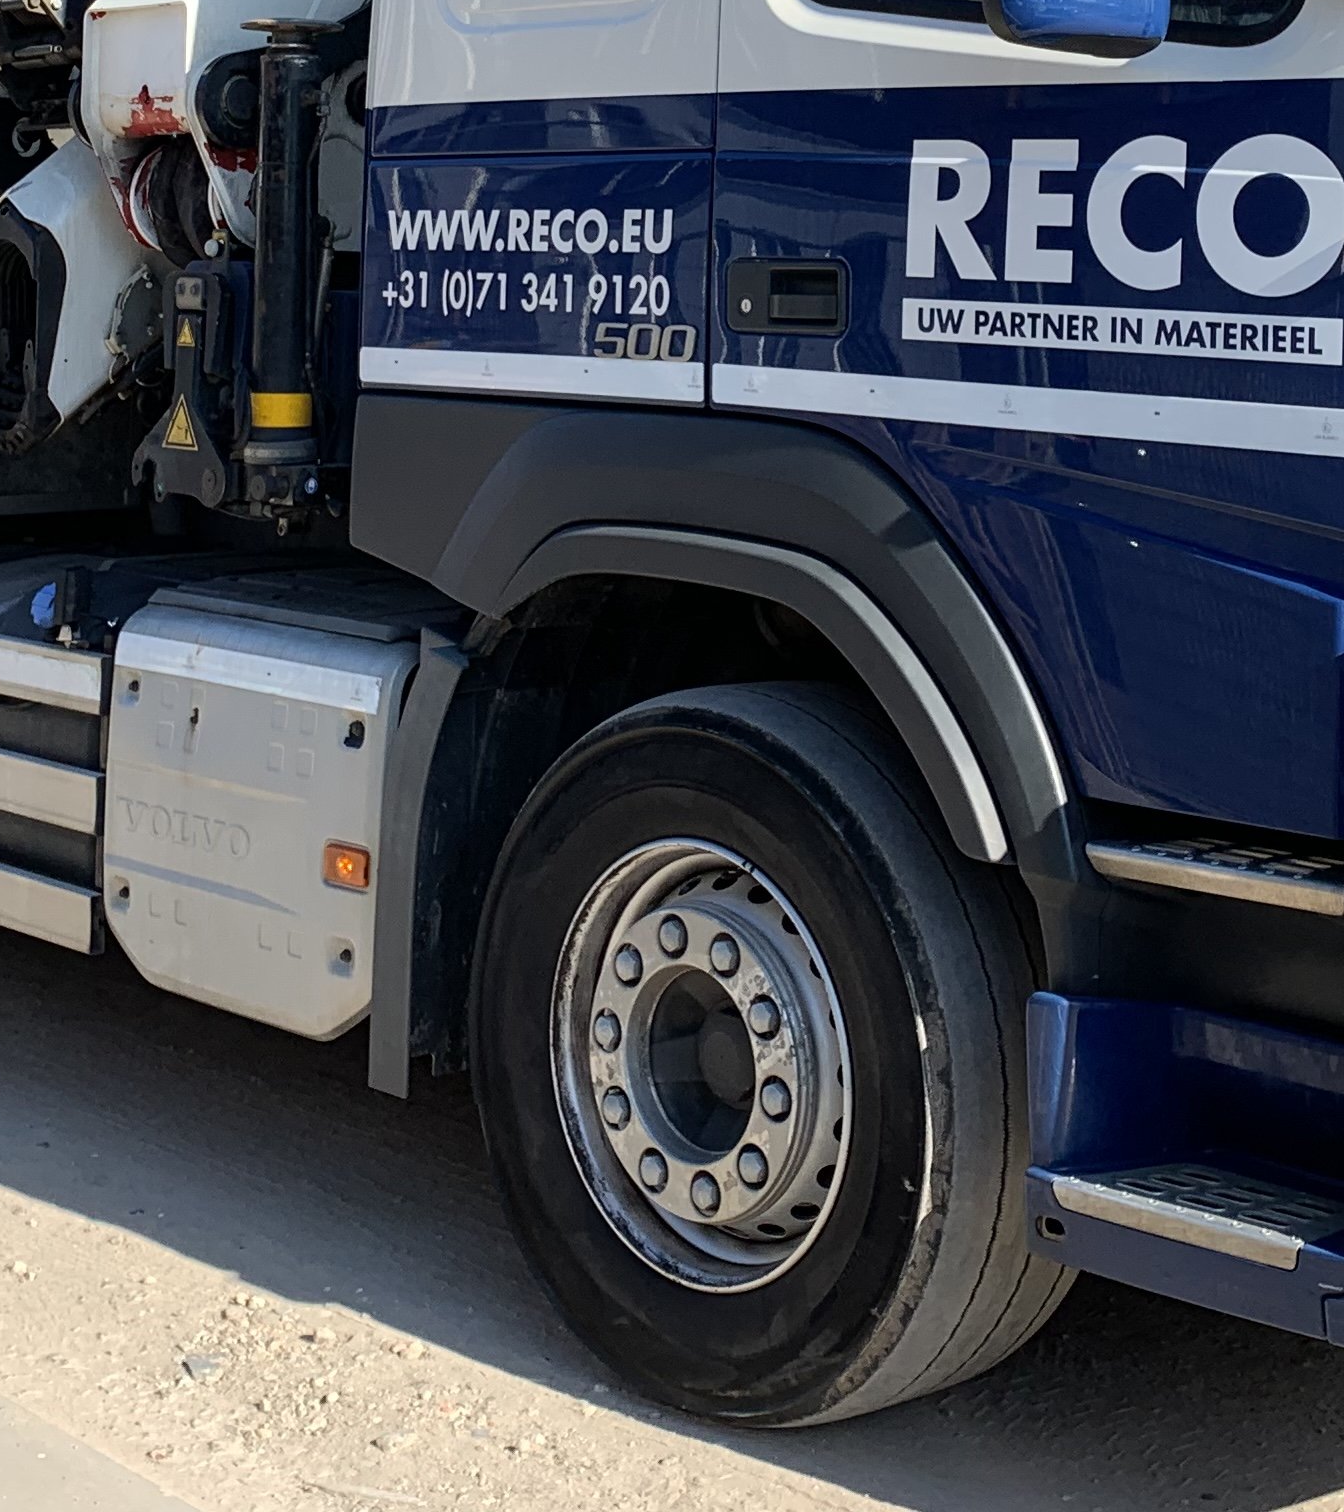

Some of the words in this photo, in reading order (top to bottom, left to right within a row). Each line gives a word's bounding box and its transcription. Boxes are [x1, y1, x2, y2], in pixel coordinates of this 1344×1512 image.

[387, 208, 674, 255] WWW.RECO.EU
[382, 269, 429, 308] +31
[442, 268, 507, 318] (0)71
[521, 272, 574, 314] 341
[588, 273, 670, 317] 9120
[593, 321, 697, 363] 500
[916, 307, 966, 335] UW
[973, 311, 1099, 343] PARTNER
[1110, 316, 1144, 345] IN
[1154, 319, 1323, 356] MATERIEEL
[116, 795, 251, 860] VOLVO
